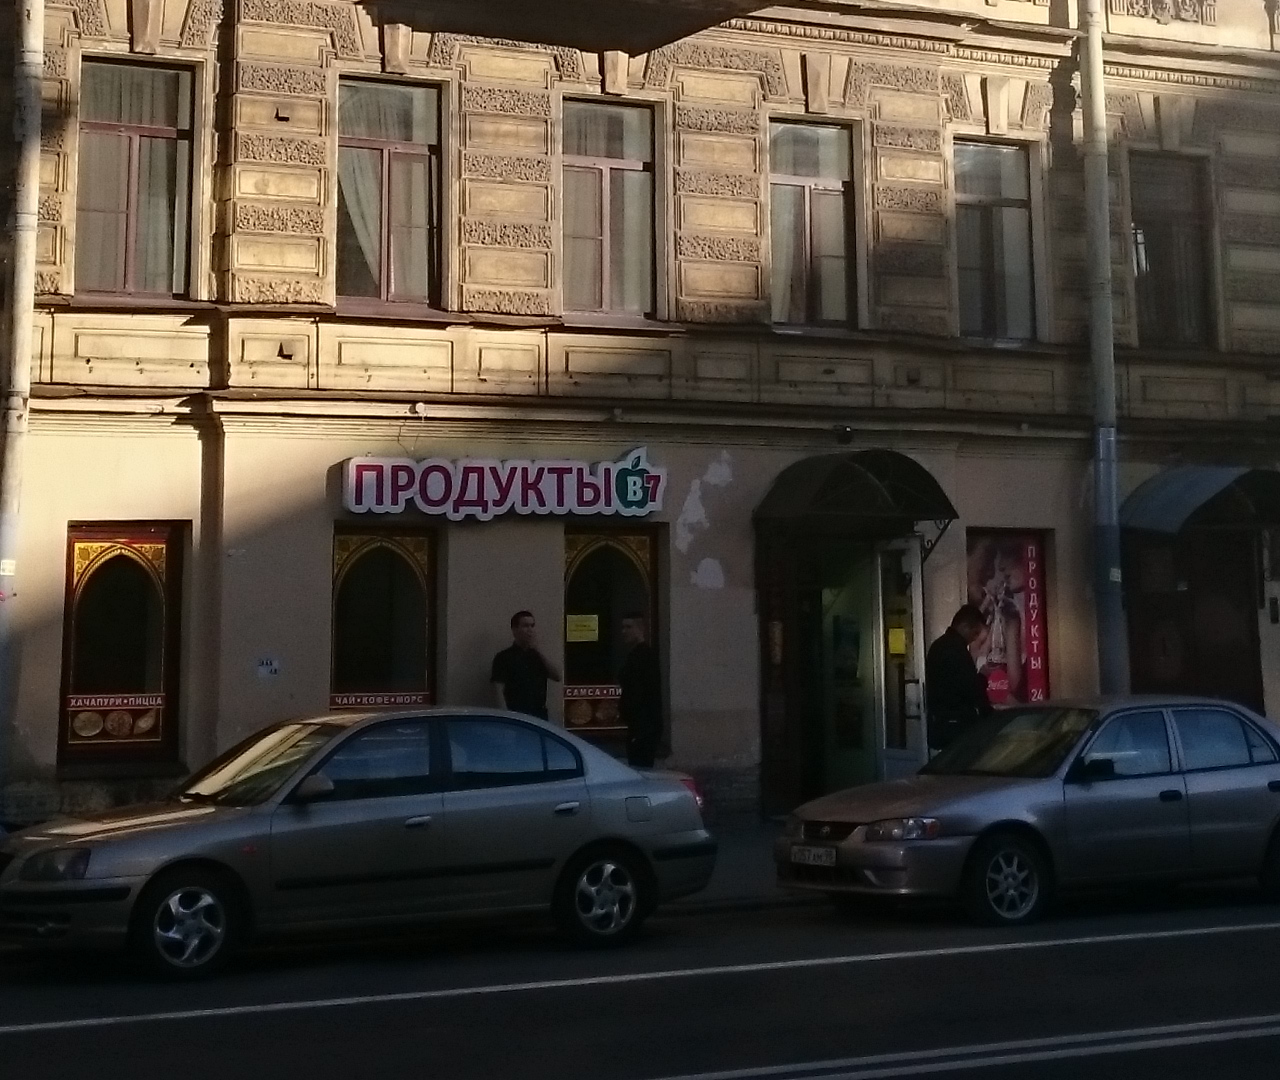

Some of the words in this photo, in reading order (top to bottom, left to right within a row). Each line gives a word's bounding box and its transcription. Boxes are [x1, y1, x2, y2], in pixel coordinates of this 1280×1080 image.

[355, 464, 611, 513] ПРОДУКТЫ
[1026, 546, 1043, 669] ПРОДУКТЫ
[565, 688, 601, 697] САМСА
[608, 687, 623, 697] ПИ
[70, 697, 123, 708] ХАЧАПУРИ
[128, 696, 163, 706] ПИЦЦА
[335, 696, 356, 705] ЧАЙ
[362, 695, 390, 705] КОФЕ
[395, 695, 424, 704] МОРС
